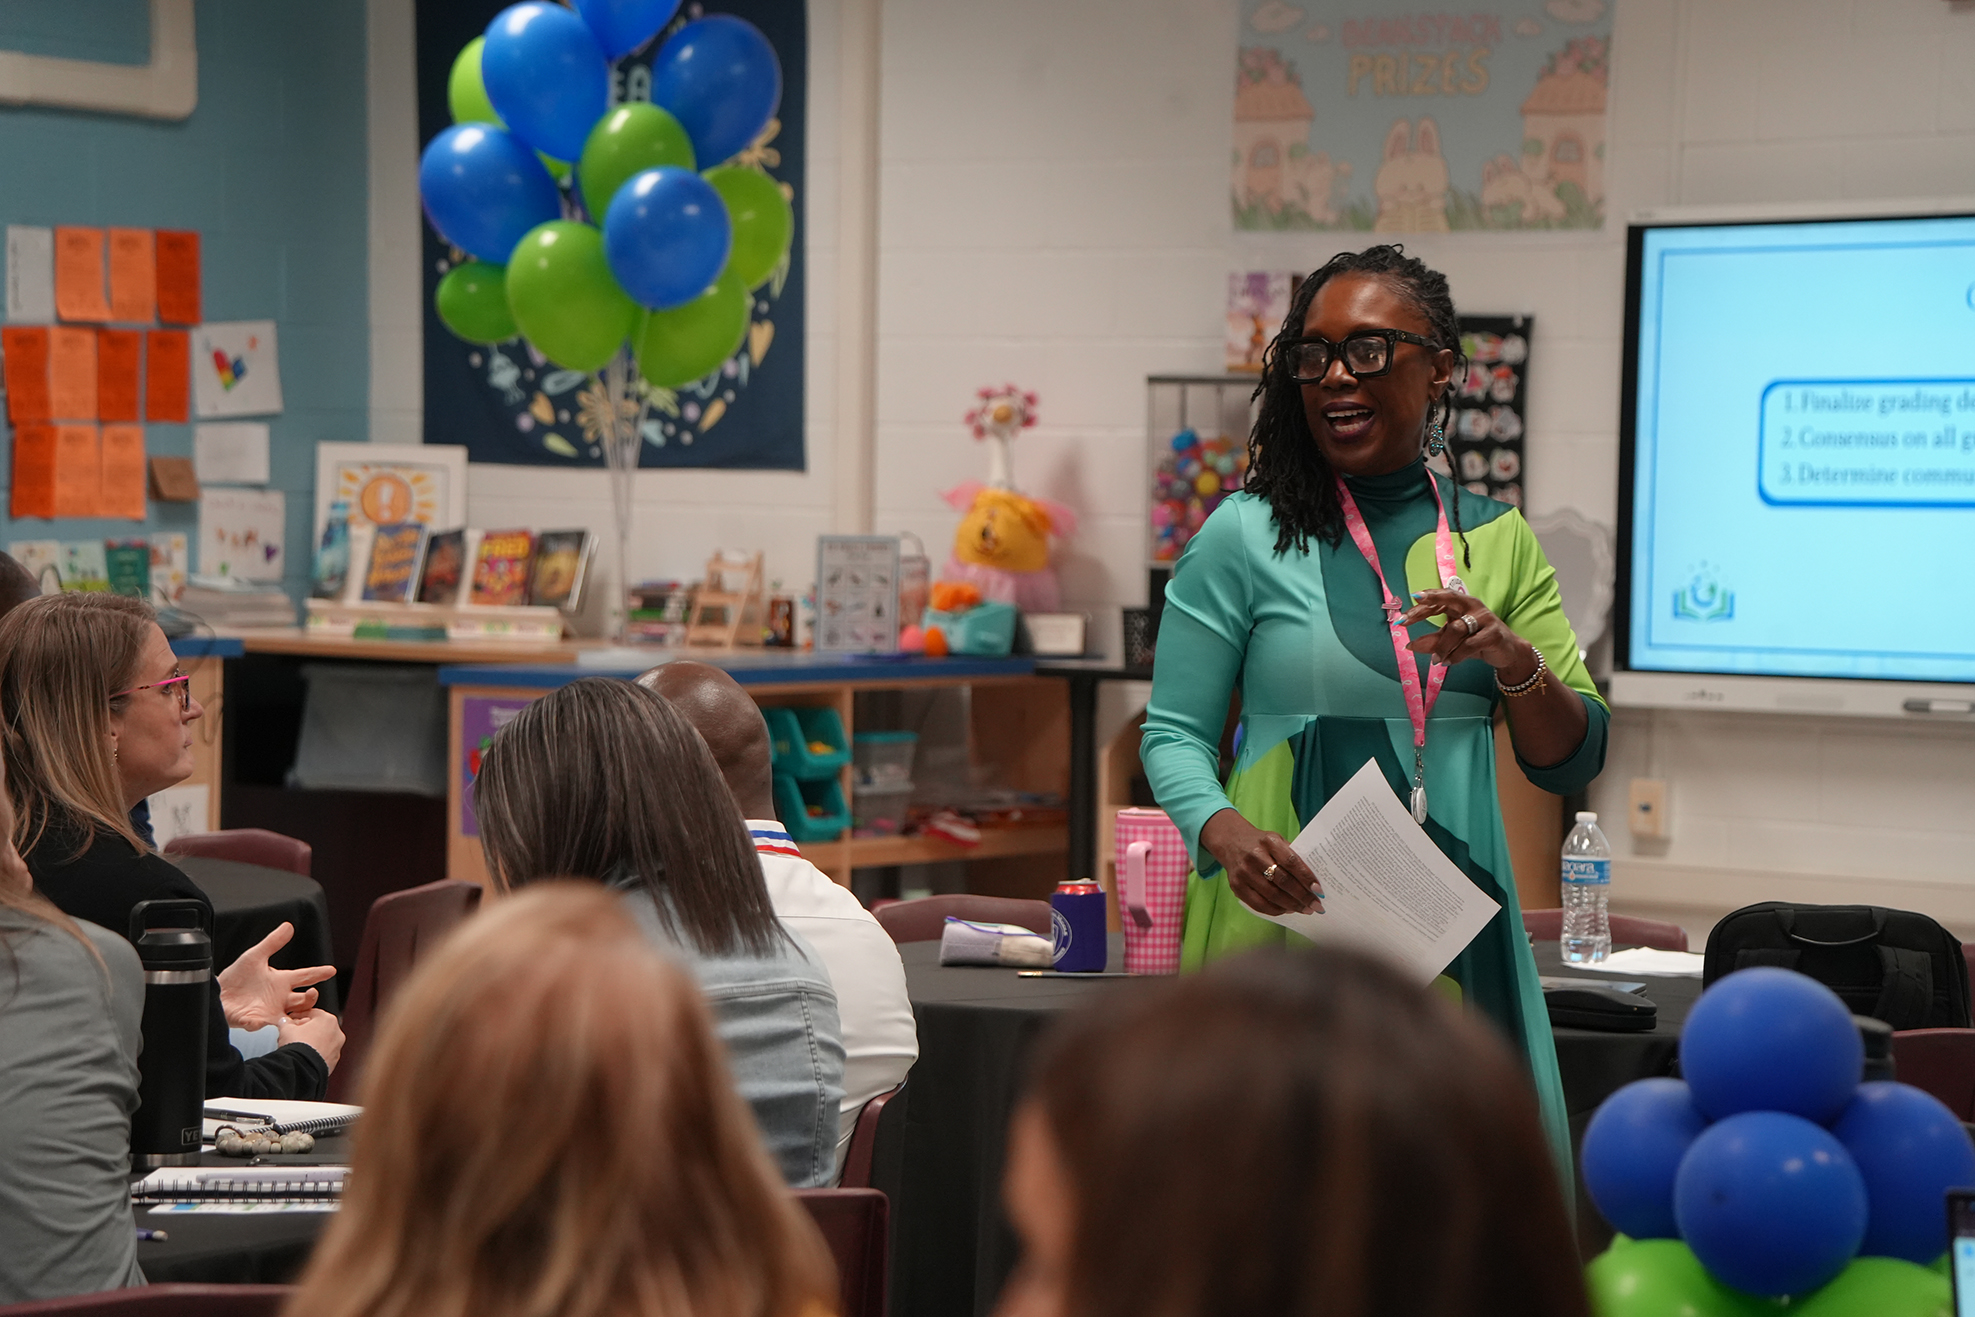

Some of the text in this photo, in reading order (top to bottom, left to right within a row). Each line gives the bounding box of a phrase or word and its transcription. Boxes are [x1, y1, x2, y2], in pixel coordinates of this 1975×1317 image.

[1347, 47, 1492, 98] PRIZES
[1801, 389, 1873, 413] Finalize
[1878, 388, 1950, 417] grading
[1799, 425, 1899, 448] Consensus
[1903, 432, 1928, 448] on
[1932, 424, 1957, 448] all
[1799, 461, 1897, 485] Determine
